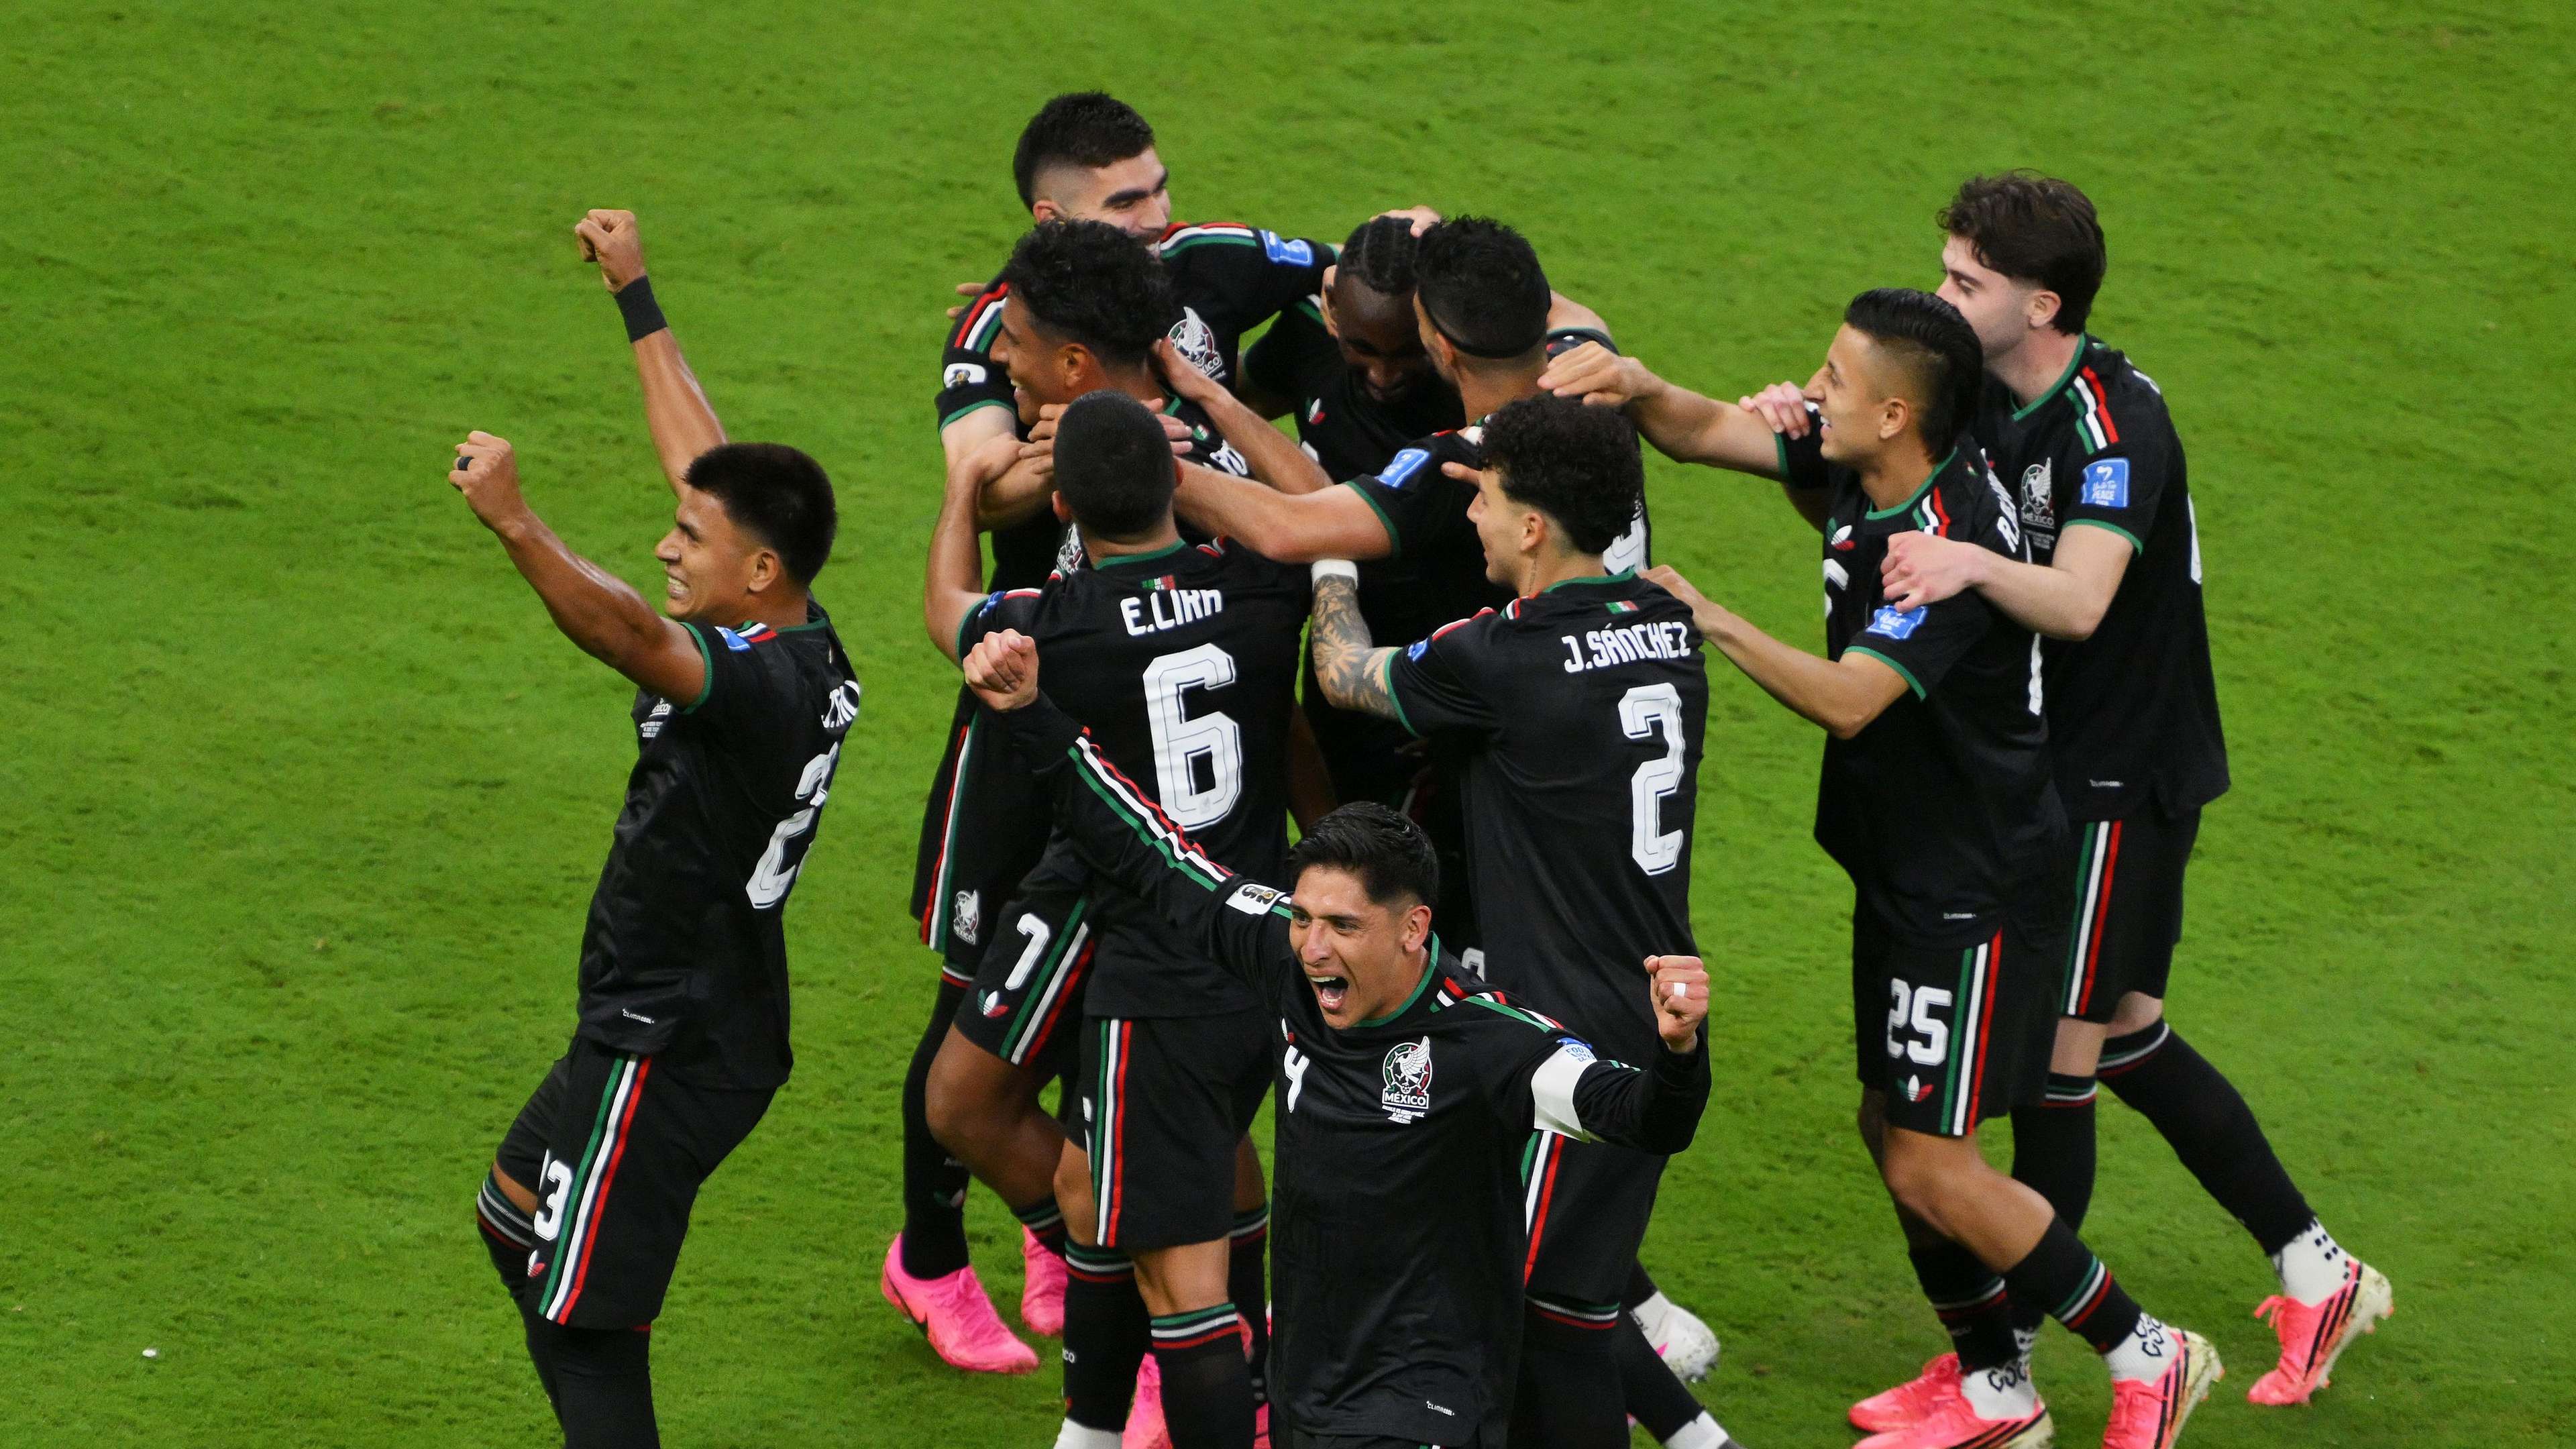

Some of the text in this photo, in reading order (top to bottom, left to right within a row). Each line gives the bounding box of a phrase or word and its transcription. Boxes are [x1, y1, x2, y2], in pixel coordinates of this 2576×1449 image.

[1561, 623, 1690, 674] J.SÁNCHEZ
[1142, 643, 1242, 831] 6
[1618, 682, 1686, 875] 2
[1005, 913, 1050, 990] 7
[1887, 977, 1953, 1067] 25
[1284, 1044, 1309, 1114] 4
[1385, 1091, 1426, 1106] MÉXICO
[534, 1148, 572, 1241] 3
